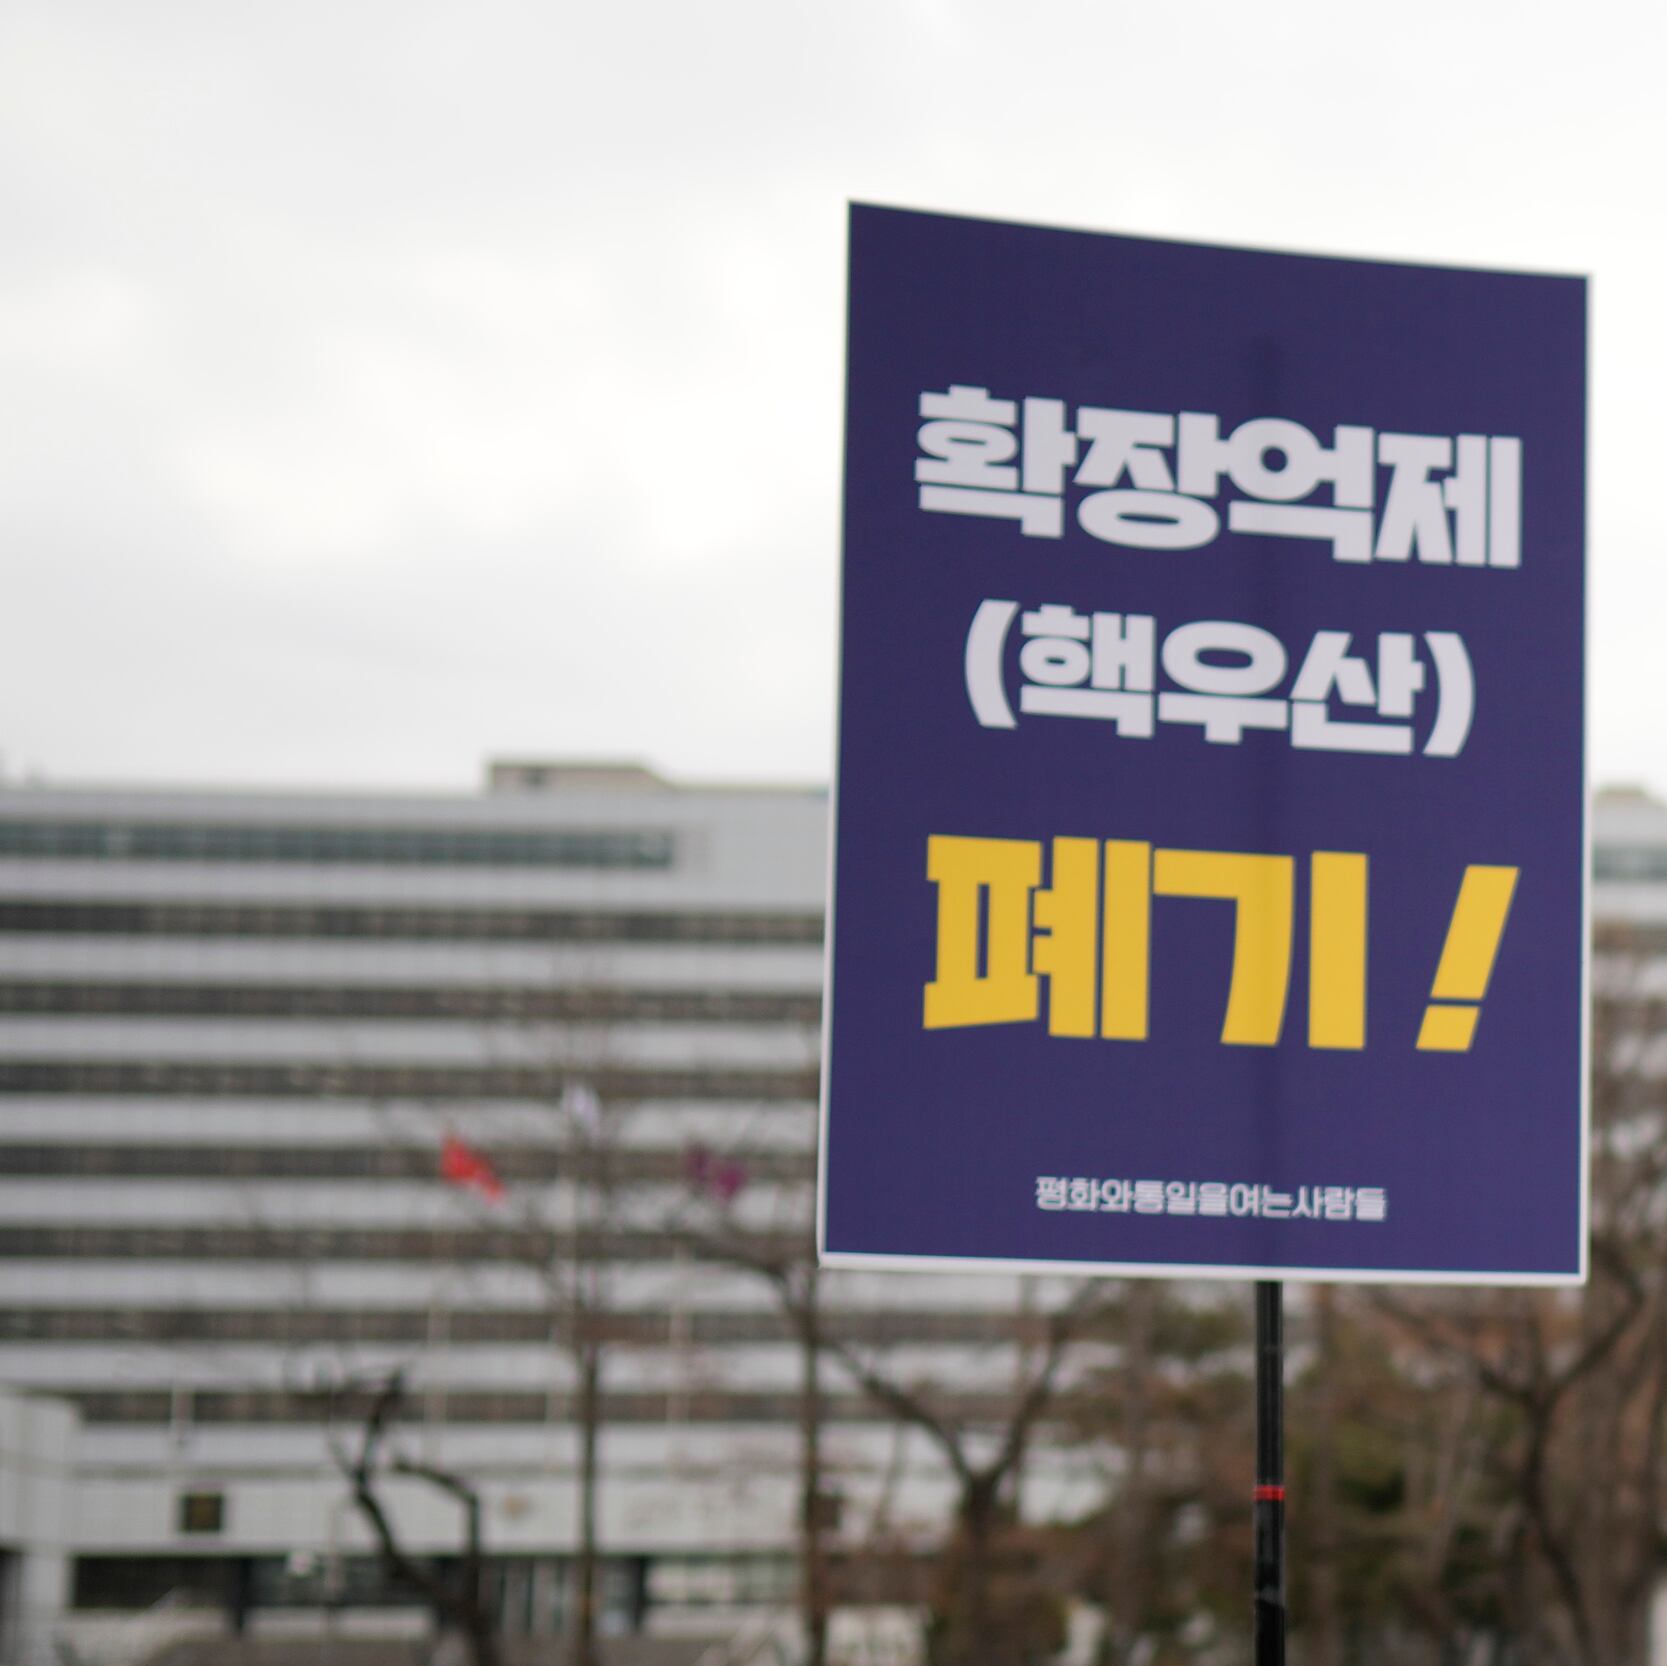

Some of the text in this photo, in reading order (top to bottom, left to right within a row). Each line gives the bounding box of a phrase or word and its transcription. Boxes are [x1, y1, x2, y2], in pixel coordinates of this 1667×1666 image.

[916, 386, 1521, 568] 확장억제
[966, 600, 1473, 756] (핵우산)
[1036, 1177, 1386, 1220] 평화와통일을여는사람들
